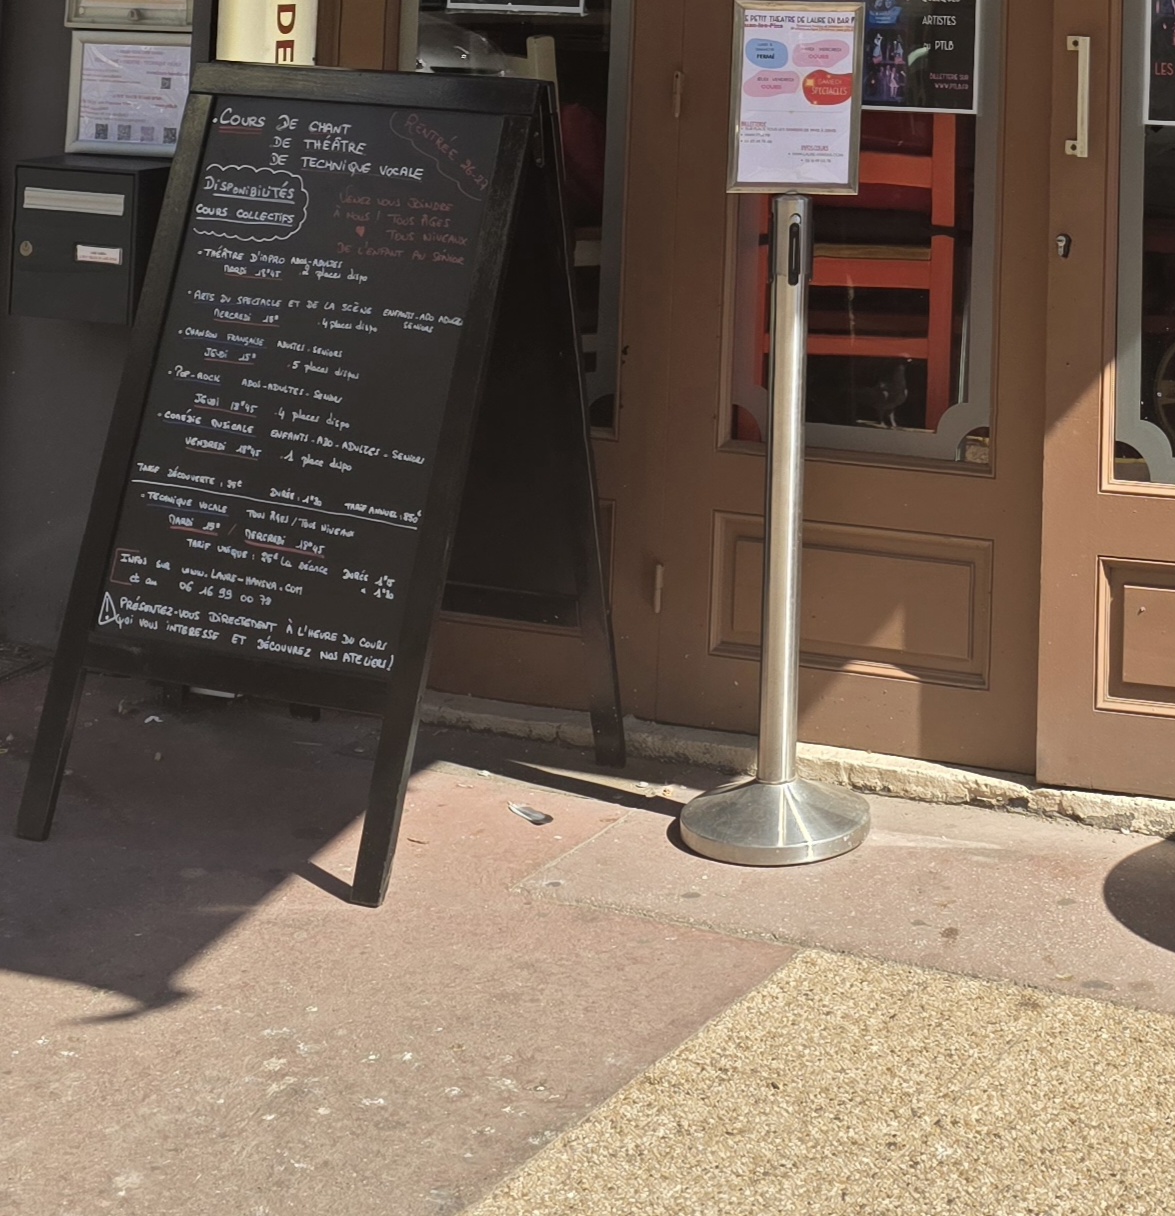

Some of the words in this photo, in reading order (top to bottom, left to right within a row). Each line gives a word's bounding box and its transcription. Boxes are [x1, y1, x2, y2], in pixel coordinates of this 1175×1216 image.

[750, 14, 767, 23] PETIT
[922, 15, 957, 26] ARTISTES
[275, 4, 296, 64] DE
[934, 40, 954, 51] PTLB
[1154, 63, 1174, 76] LES
[811, 87, 848, 96] SPECTACLES
[308, 121, 352, 135] CHANT
[271, 136, 293, 149] DE
[303, 134, 367, 155] THÉÂTRE
[269, 152, 289, 166] DE
[379, 165, 424, 180] VOCALE
[195, 203, 228, 217] COURS
[288, 299, 301, 308] ET
[306, 300, 319, 309] DE
[323, 302, 335, 311] LA
[291, 361, 300, 370] 5
[277, 407, 285, 420] 4
[291, 409, 320, 423] places
[284, 450, 294, 462] 1
[301, 454, 324, 468] place
[179, 581, 194, 593] 06
[217, 587, 233, 600] 99
[231, 634, 247, 645] ET
[319, 650, 339, 661] NOS
